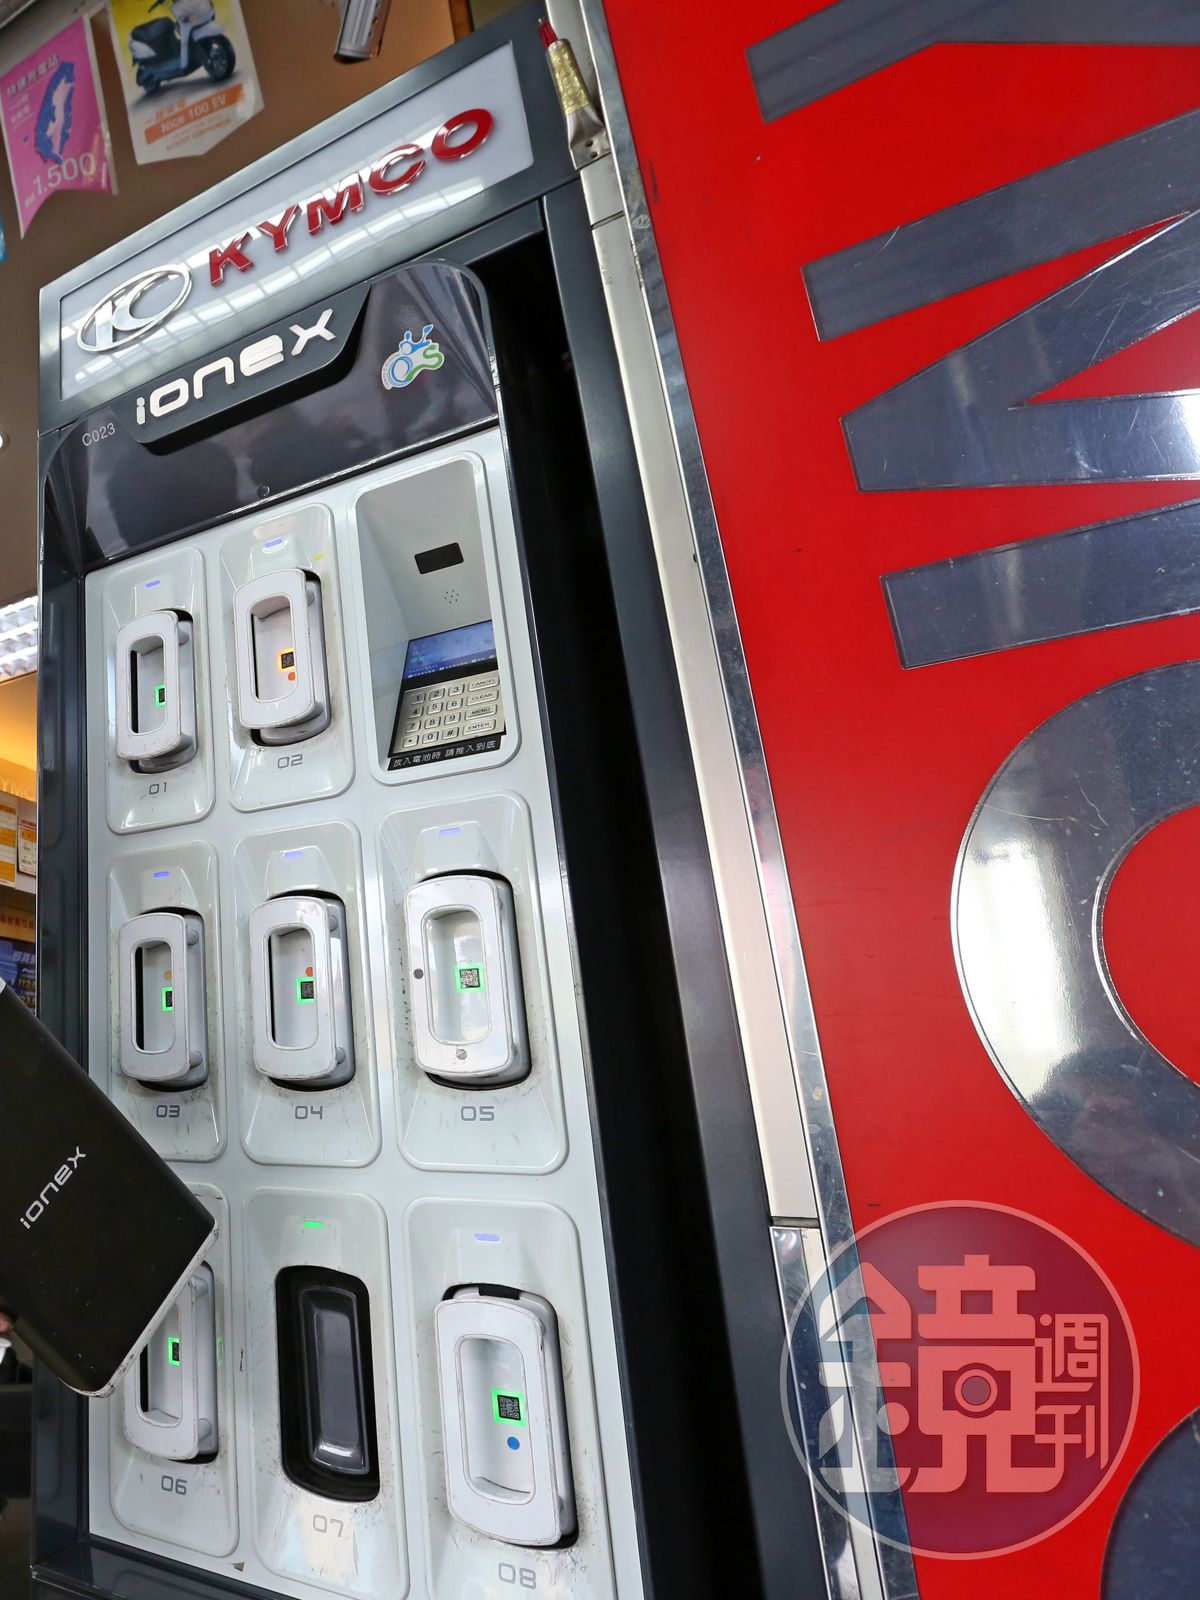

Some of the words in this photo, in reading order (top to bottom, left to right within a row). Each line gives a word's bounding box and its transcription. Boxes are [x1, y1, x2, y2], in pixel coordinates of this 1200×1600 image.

[208, 108, 494, 286] KYMCO
[135, 308, 337, 426] ionex
[81, 422, 116, 448] C023
[277, 753, 303, 769] 02
[148, 782, 168, 795] 01
[155, 1104, 180, 1118] 03
[294, 1105, 323, 1120] 04
[460, 1105, 495, 1121] 05
[20, 1146, 86, 1229] ionex
[161, 1475, 187, 1495] 06
[312, 1514, 344, 1538] 07
[498, 1562, 537, 1589] 08
